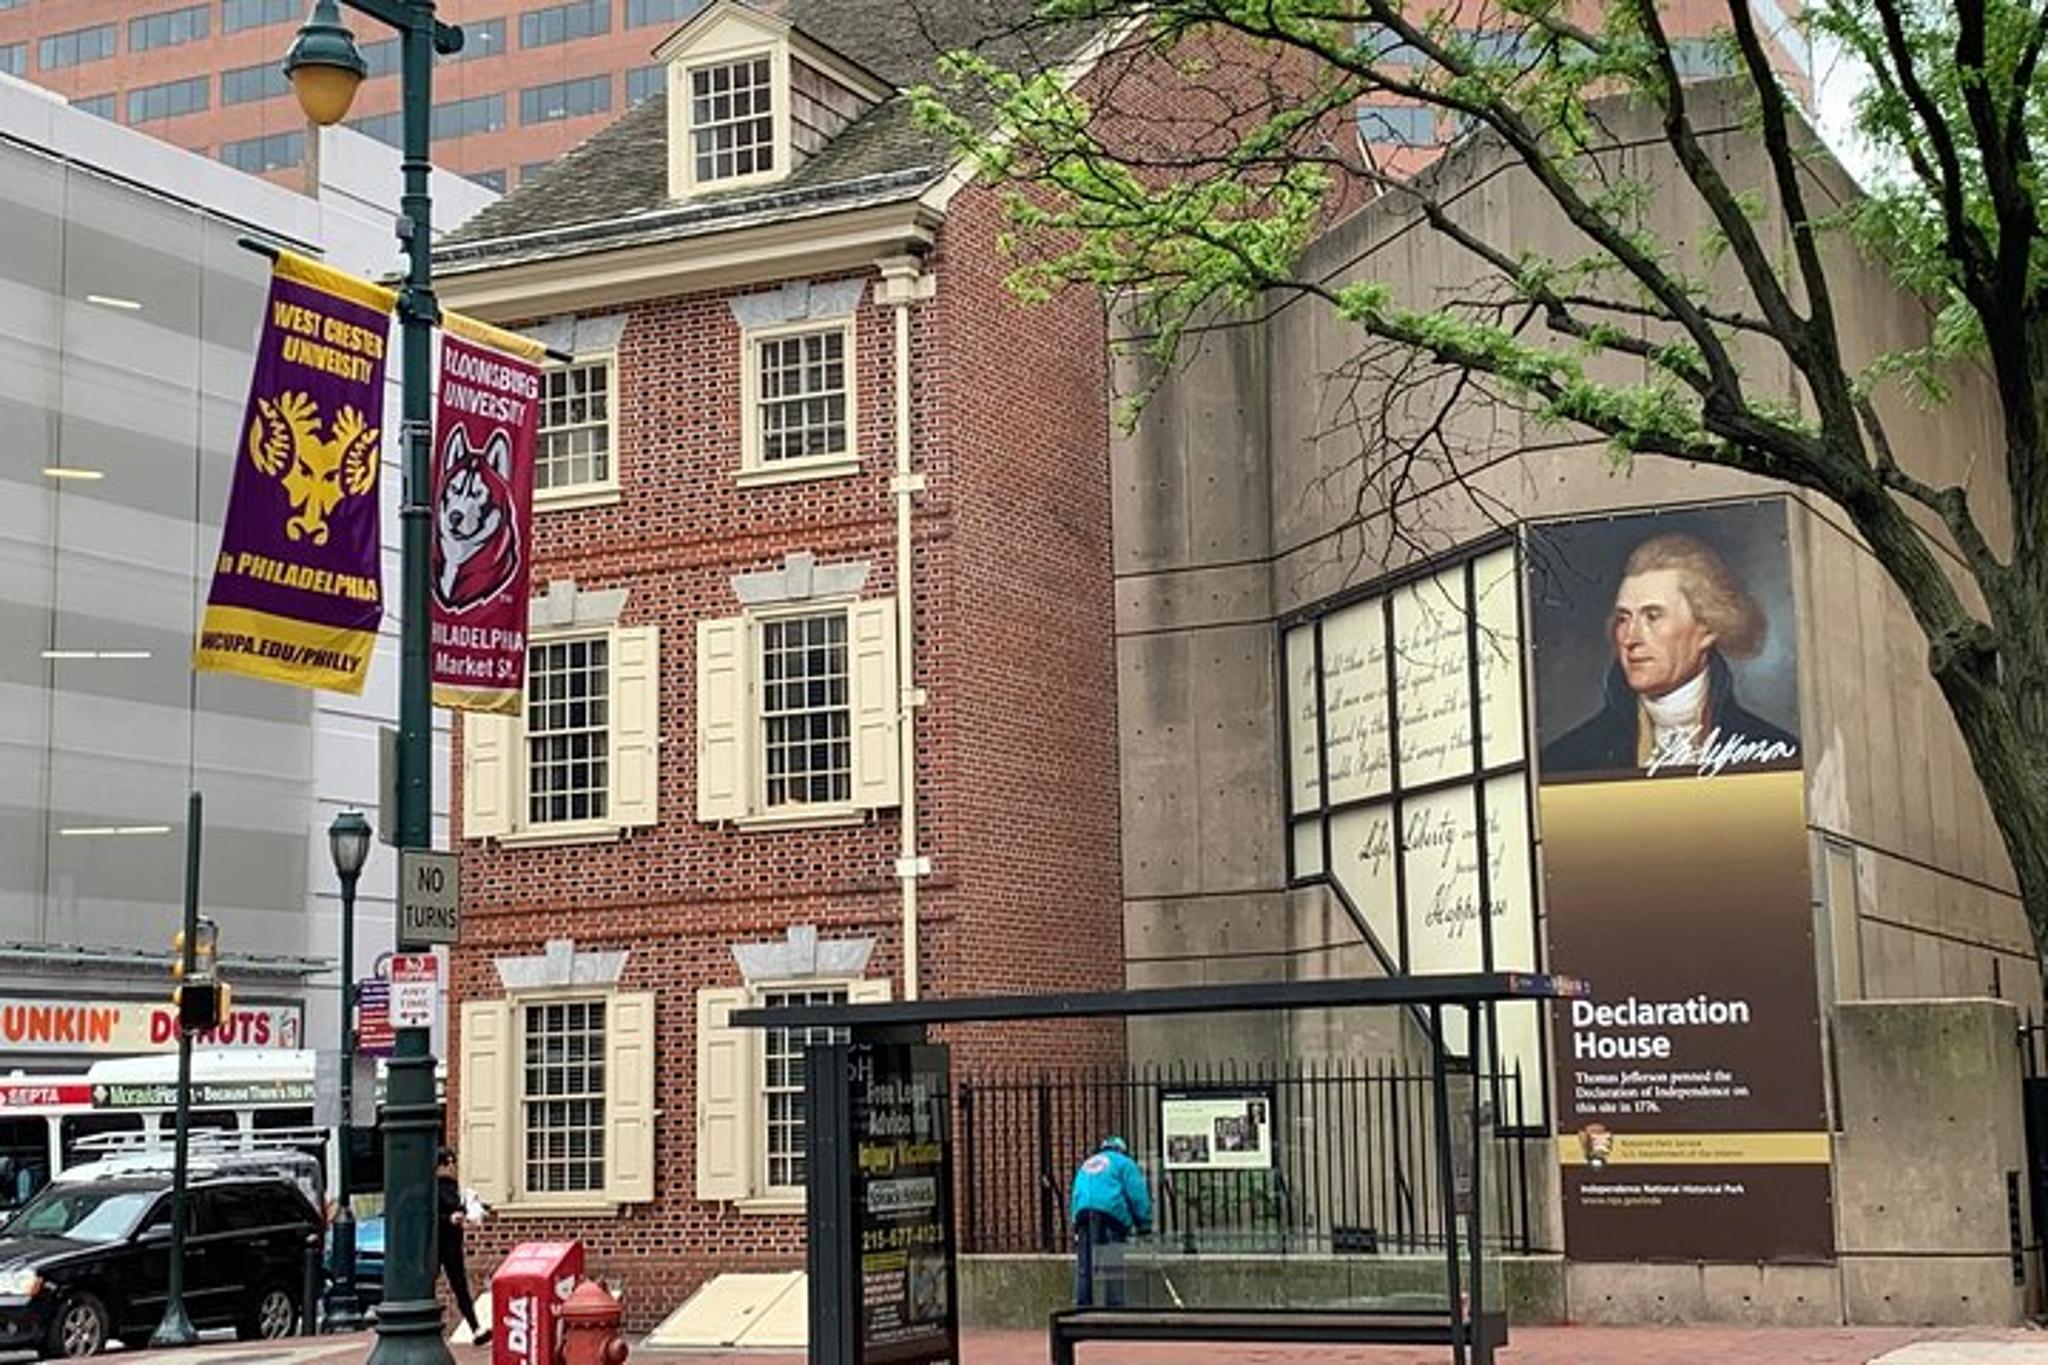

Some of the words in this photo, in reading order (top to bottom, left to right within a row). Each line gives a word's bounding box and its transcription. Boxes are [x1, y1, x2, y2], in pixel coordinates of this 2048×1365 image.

[274, 301, 322, 338] WEST
[323, 316, 384, 359] CHESTER
[283, 335, 373, 385] UNIVERSITY
[443, 380, 527, 427] UNIVERSITY
[237, 553, 378, 601] PHILADELPHIA
[435, 651, 494, 679] Market
[417, 865, 445, 893] NO
[405, 905, 457, 929] TURNS
[2, 1005, 120, 1043] UNKIN'
[1572, 995, 1750, 1027] Declaration
[1574, 1031, 1671, 1059] House
[1575, 1072, 1618, 1083] Thomas
[1620, 1072, 1667, 1084] Jefferson
[1670, 1071, 1711, 1084] penned
[1714, 1071, 1732, 1082] the
[8, 1087, 59, 1104] SEPTA
[1575, 1086, 1638, 1098] Declaration
[1641, 1086, 1652, 1096] of
[1655, 1085, 1730, 1099] Independence
[1576, 1102, 1596, 1113] this
[1599, 1102, 1616, 1113] site
[1620, 1102, 1631, 1113] in
[1580, 1185, 1642, 1196] Independence
[1643, 1185, 1679, 1194] National
[1682, 1184, 1722, 1194] Historical
[1724, 1184, 1745, 1194] Park
